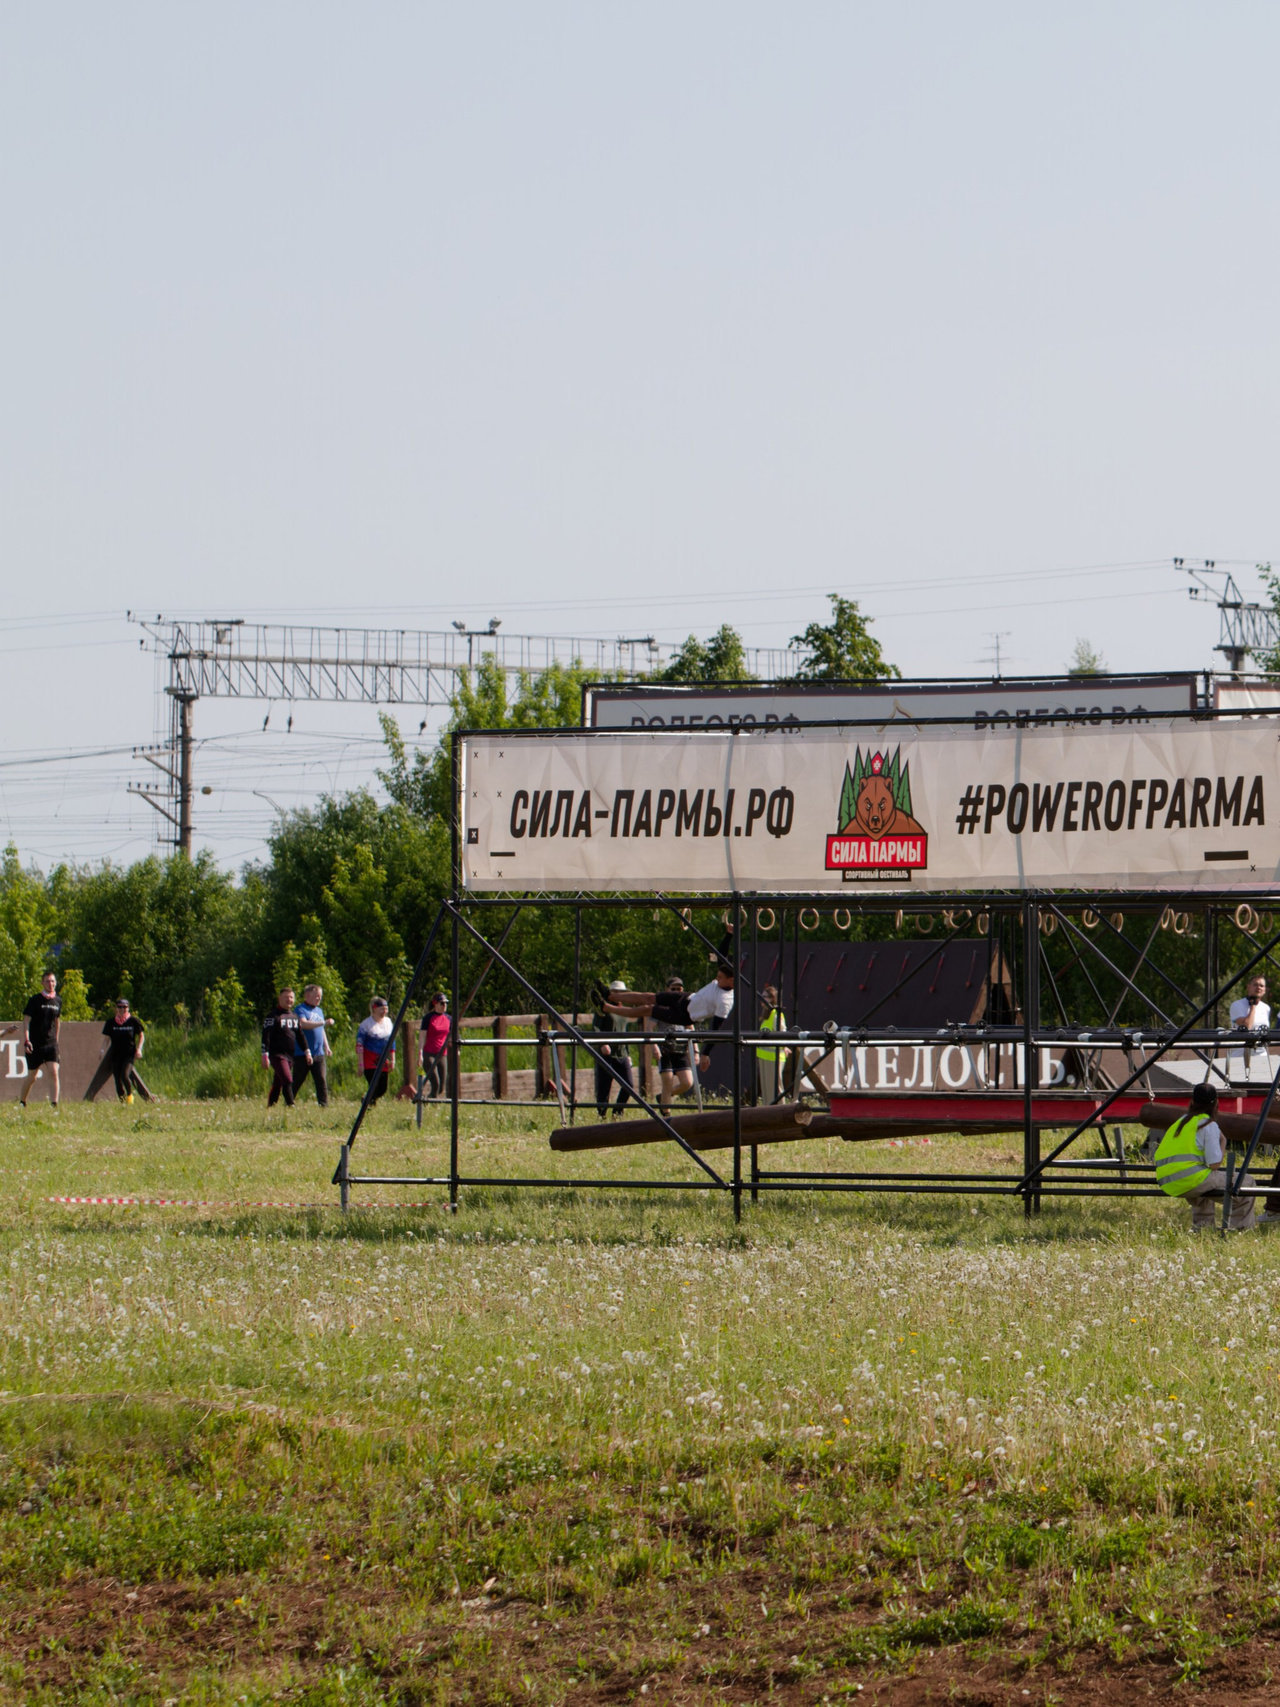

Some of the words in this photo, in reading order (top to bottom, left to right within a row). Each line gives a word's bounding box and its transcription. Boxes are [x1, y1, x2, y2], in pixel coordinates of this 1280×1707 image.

[509, 785, 795, 839] СИЛА-ПАРМЫ.РФ
[955, 775, 1266, 835] #POWEROFPARMA
[831, 841, 867, 864] СИЛА
[869, 841, 922, 863] ПАРМЫ
[280, 1018, 299, 1029] FOX
